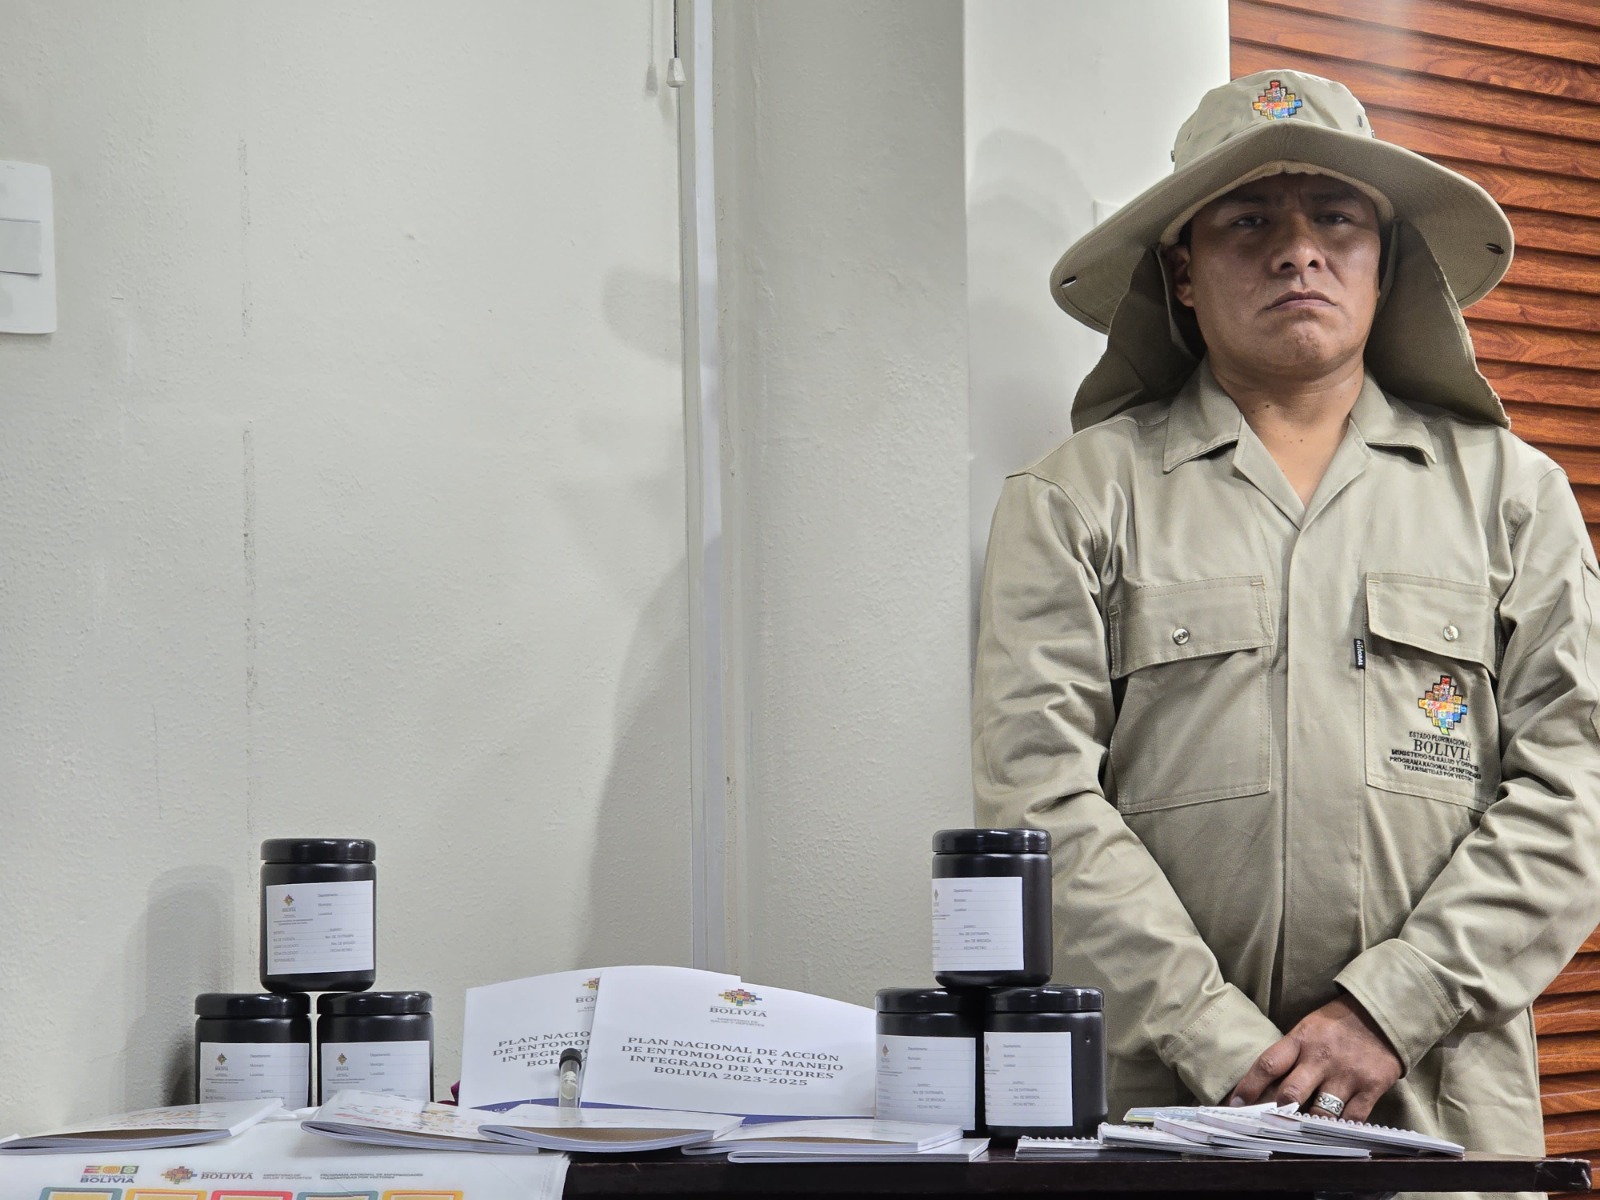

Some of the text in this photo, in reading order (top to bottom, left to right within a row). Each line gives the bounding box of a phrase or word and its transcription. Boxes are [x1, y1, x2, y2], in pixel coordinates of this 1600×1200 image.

[1408, 731, 1431, 740] ESTADO
[1413, 738, 1471, 761] BOLIVIA
[709, 1007, 767, 1017] BOLIVIA
[498, 1031, 591, 1047] PLAN NACIO
[492, 1047, 514, 1056] DE
[621, 1045, 844, 1072] DE ENTOMOLOGÍA Y MANEJO
[628, 1037, 840, 1062] PLAN NACIONAL DE ACCIÓN
[630, 1055, 835, 1080] INTEGRADO DE VECTORES
[653, 1066, 808, 1086] BOLIVIA 2023-2025
[200, 1172, 254, 1180] BOLIVIA
